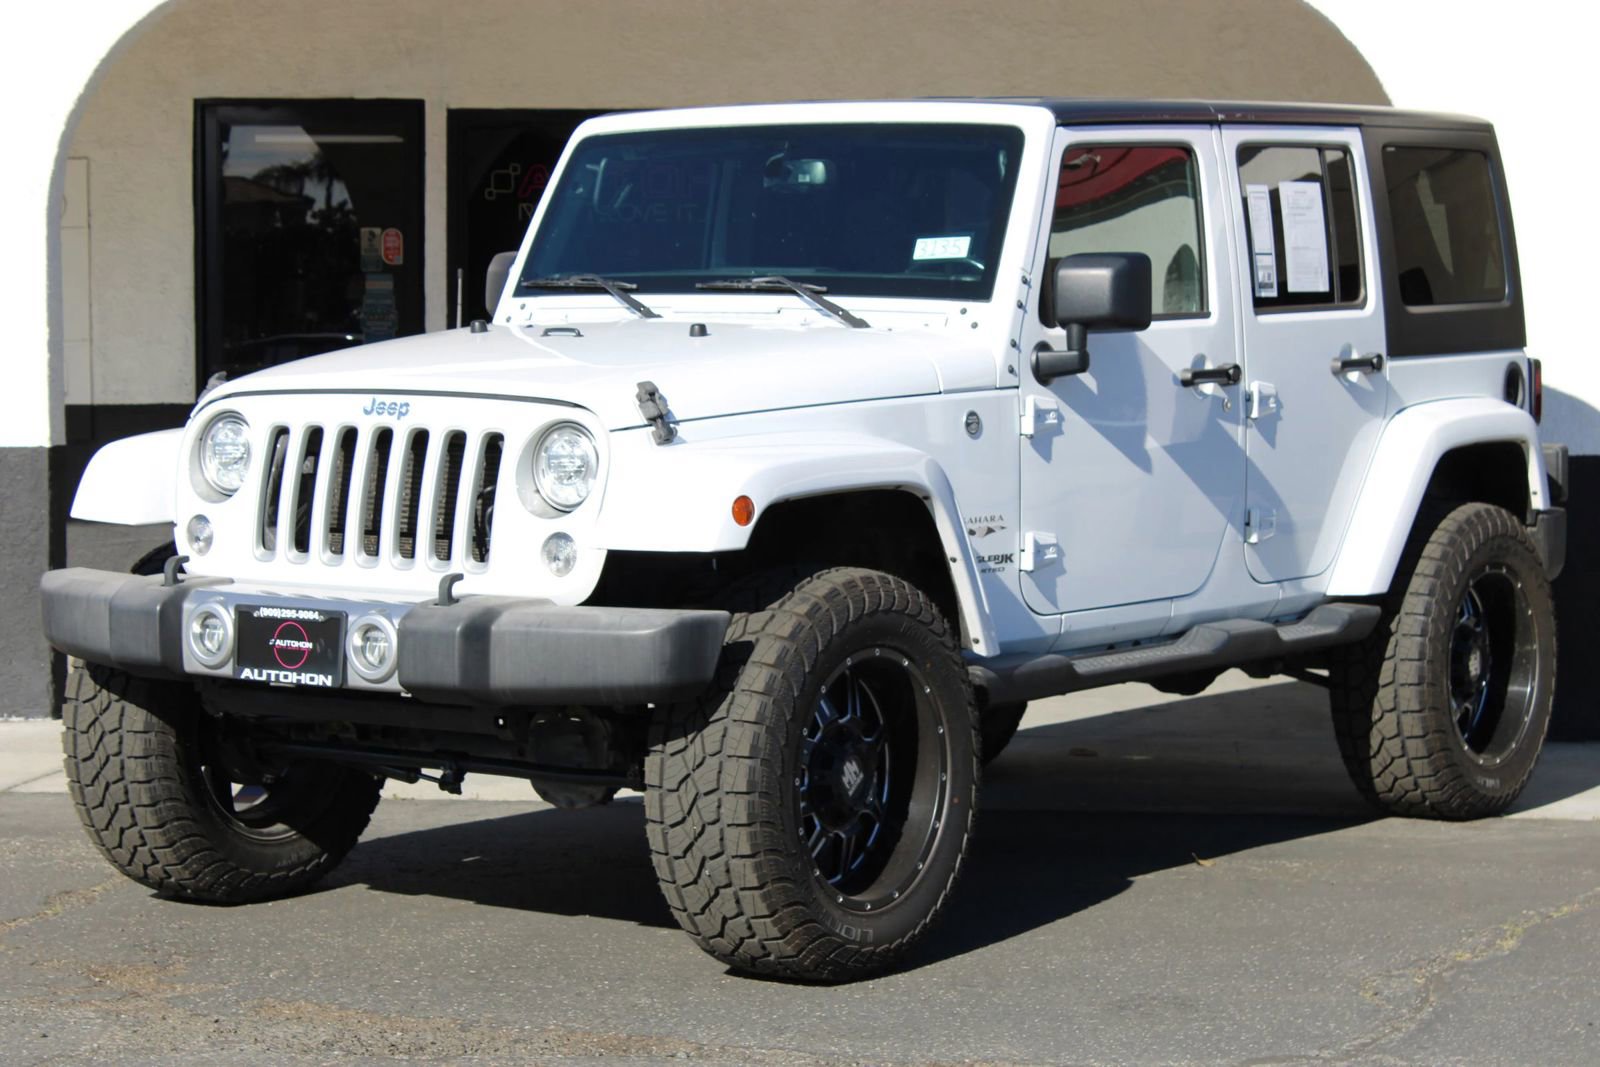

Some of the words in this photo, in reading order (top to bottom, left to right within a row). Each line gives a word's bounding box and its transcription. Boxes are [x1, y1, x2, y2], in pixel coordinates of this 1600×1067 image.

[363, 397, 410, 420] Jeep
[275, 638, 313, 649] AUTOHON
[240, 667, 333, 687] AUTOHON
